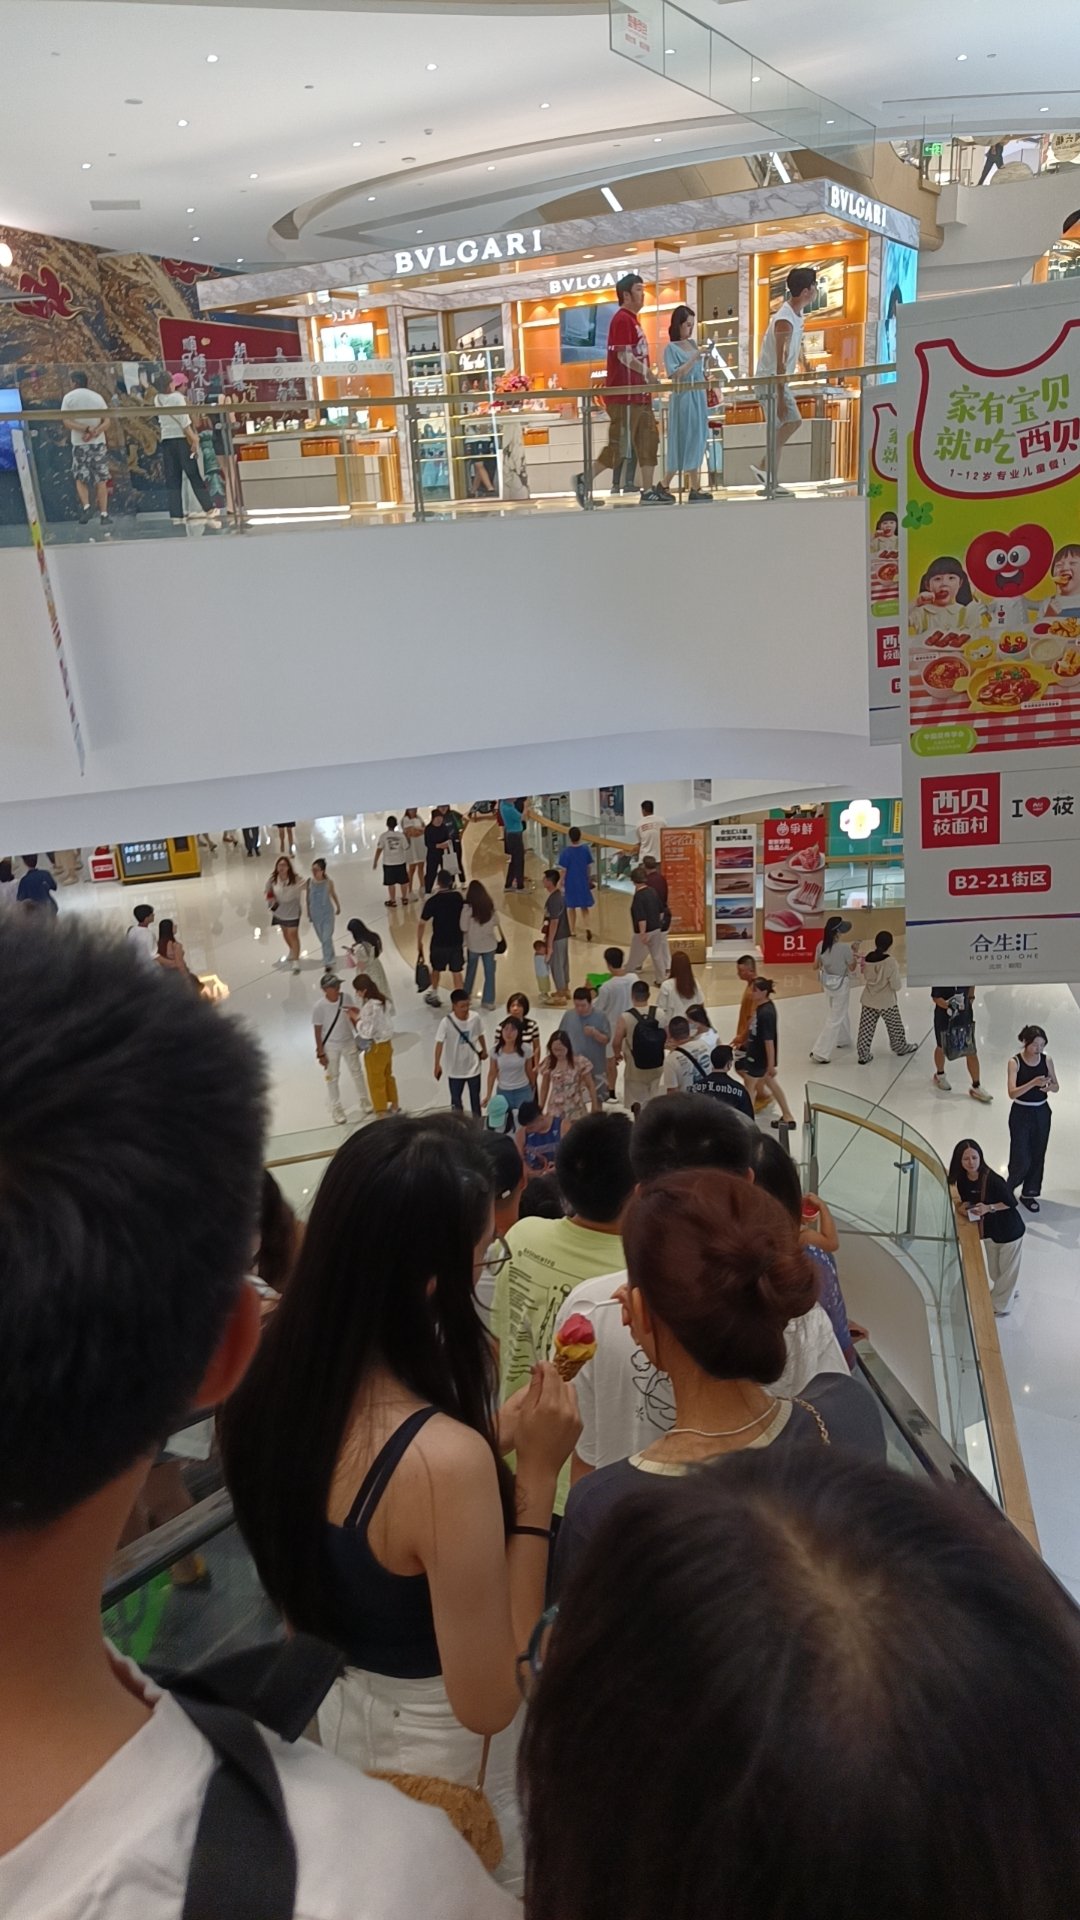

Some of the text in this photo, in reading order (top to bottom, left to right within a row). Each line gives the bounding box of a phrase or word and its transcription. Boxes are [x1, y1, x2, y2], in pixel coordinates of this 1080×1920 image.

[830, 185, 887, 227] BVLGARI
[394, 229, 543, 274] BVLGARI
[946, 373, 1070, 426] 家有宝贝
[932, 416, 1080, 465] 就吃西贝
[932, 788, 989, 816] 西贝
[1052, 796, 1075, 816] 莜
[933, 816, 988, 836] 莜面村
[955, 870, 1047, 890] B2-21街区
[784, 935, 807, 950] B1
[970, 932, 1039, 953] 合生汇
[708, 1081, 743, 1097] London
